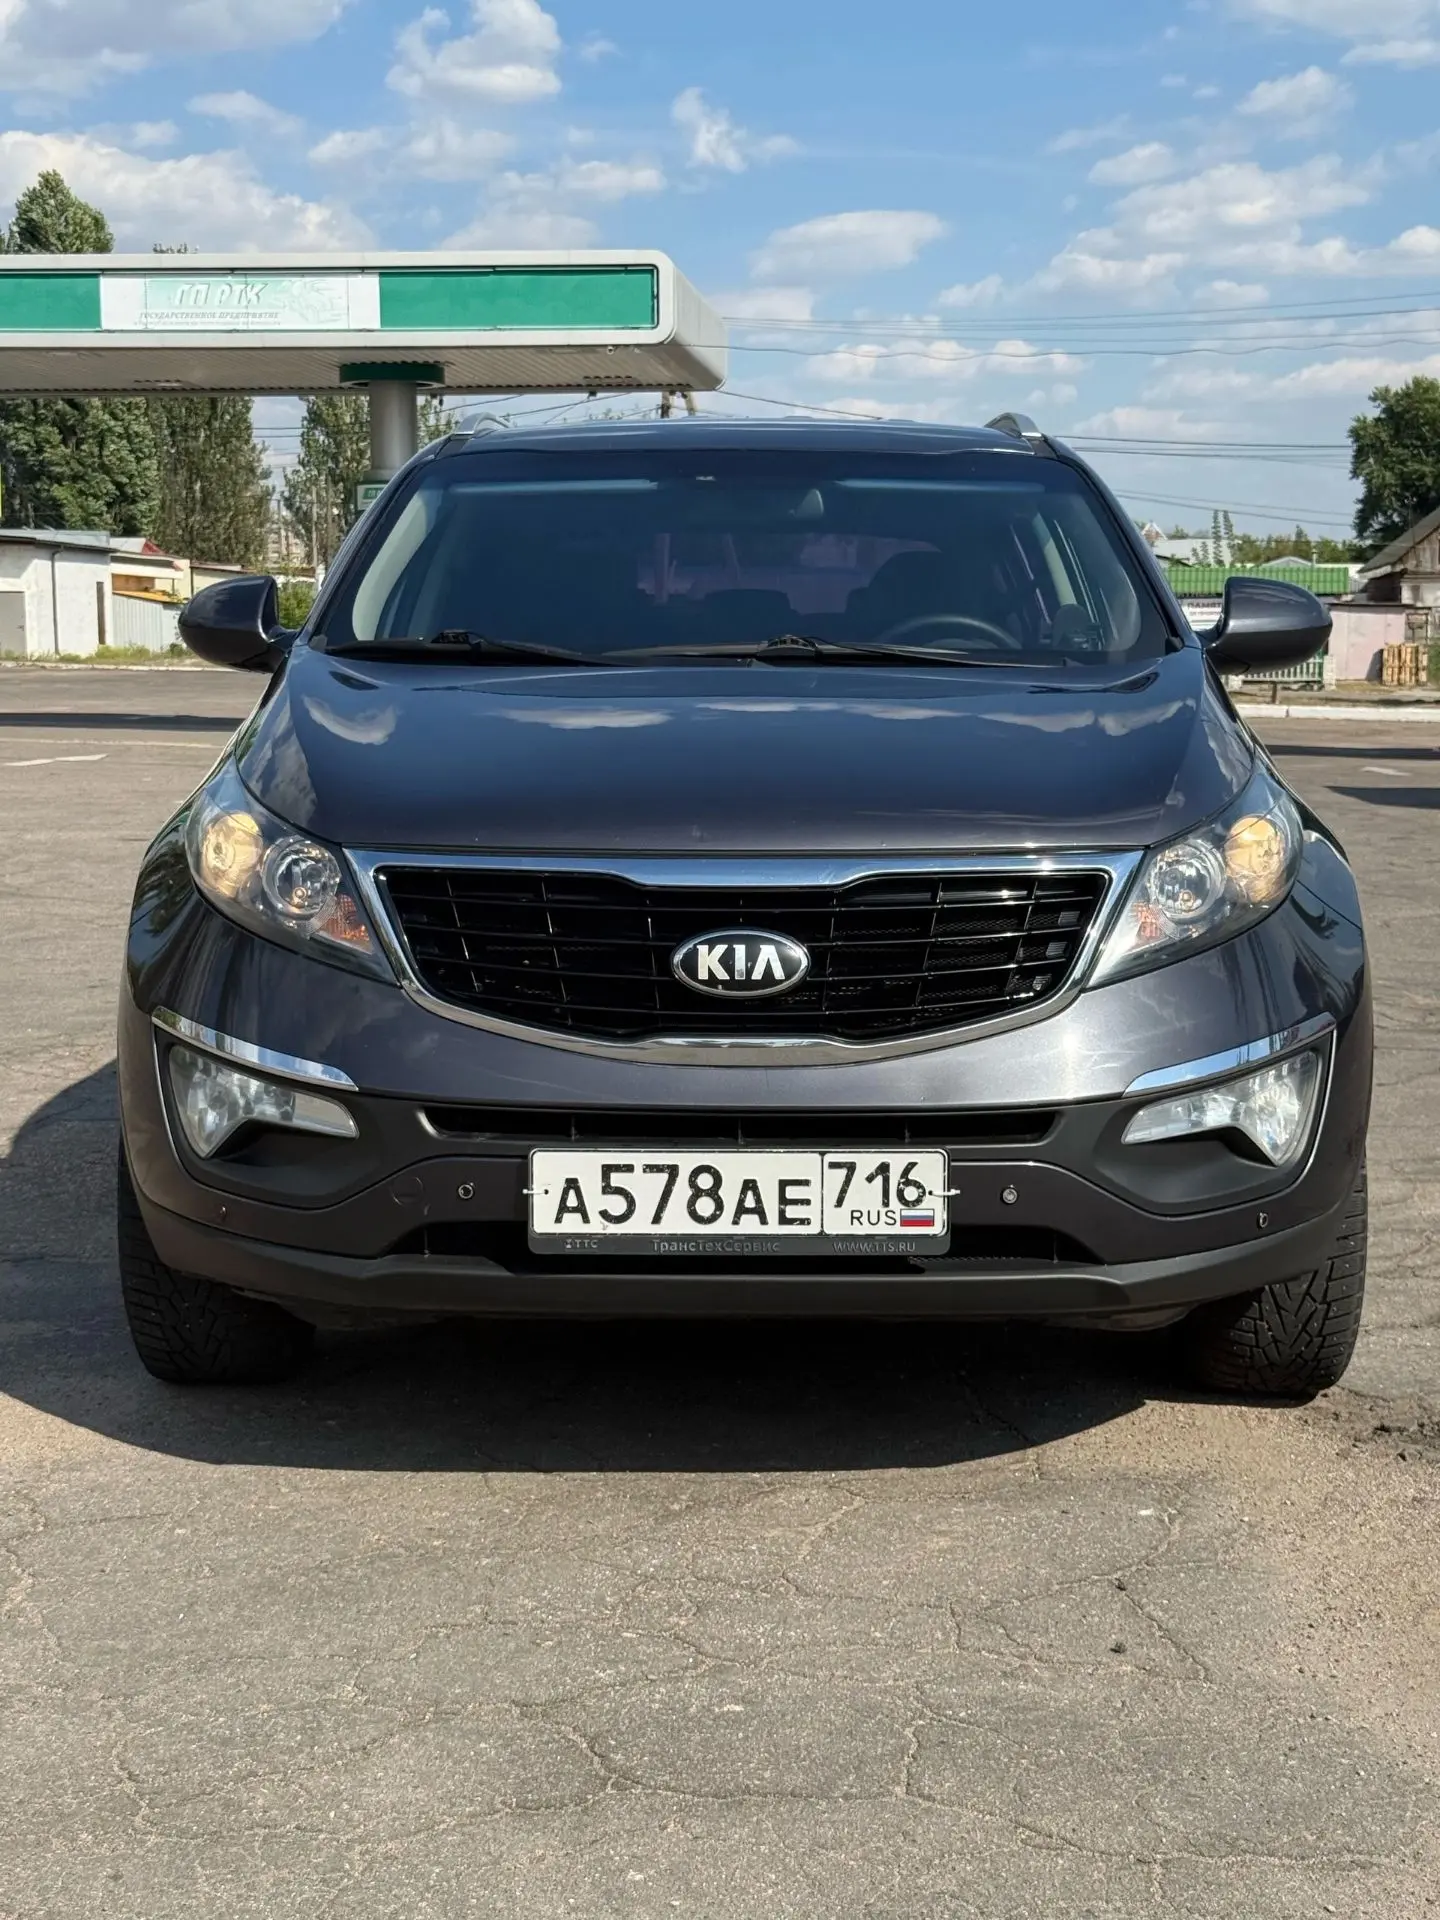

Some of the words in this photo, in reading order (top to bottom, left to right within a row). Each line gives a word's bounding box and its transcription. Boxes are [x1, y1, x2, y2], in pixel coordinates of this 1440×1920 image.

[696, 944, 786, 980] KIA
[827, 1161, 928, 1209] 716
[849, 1208, 898, 1226] RUS
[651, 1239, 781, 1253] ТрансТехСервис
[833, 1241, 917, 1252] WWW.TTS.RU
